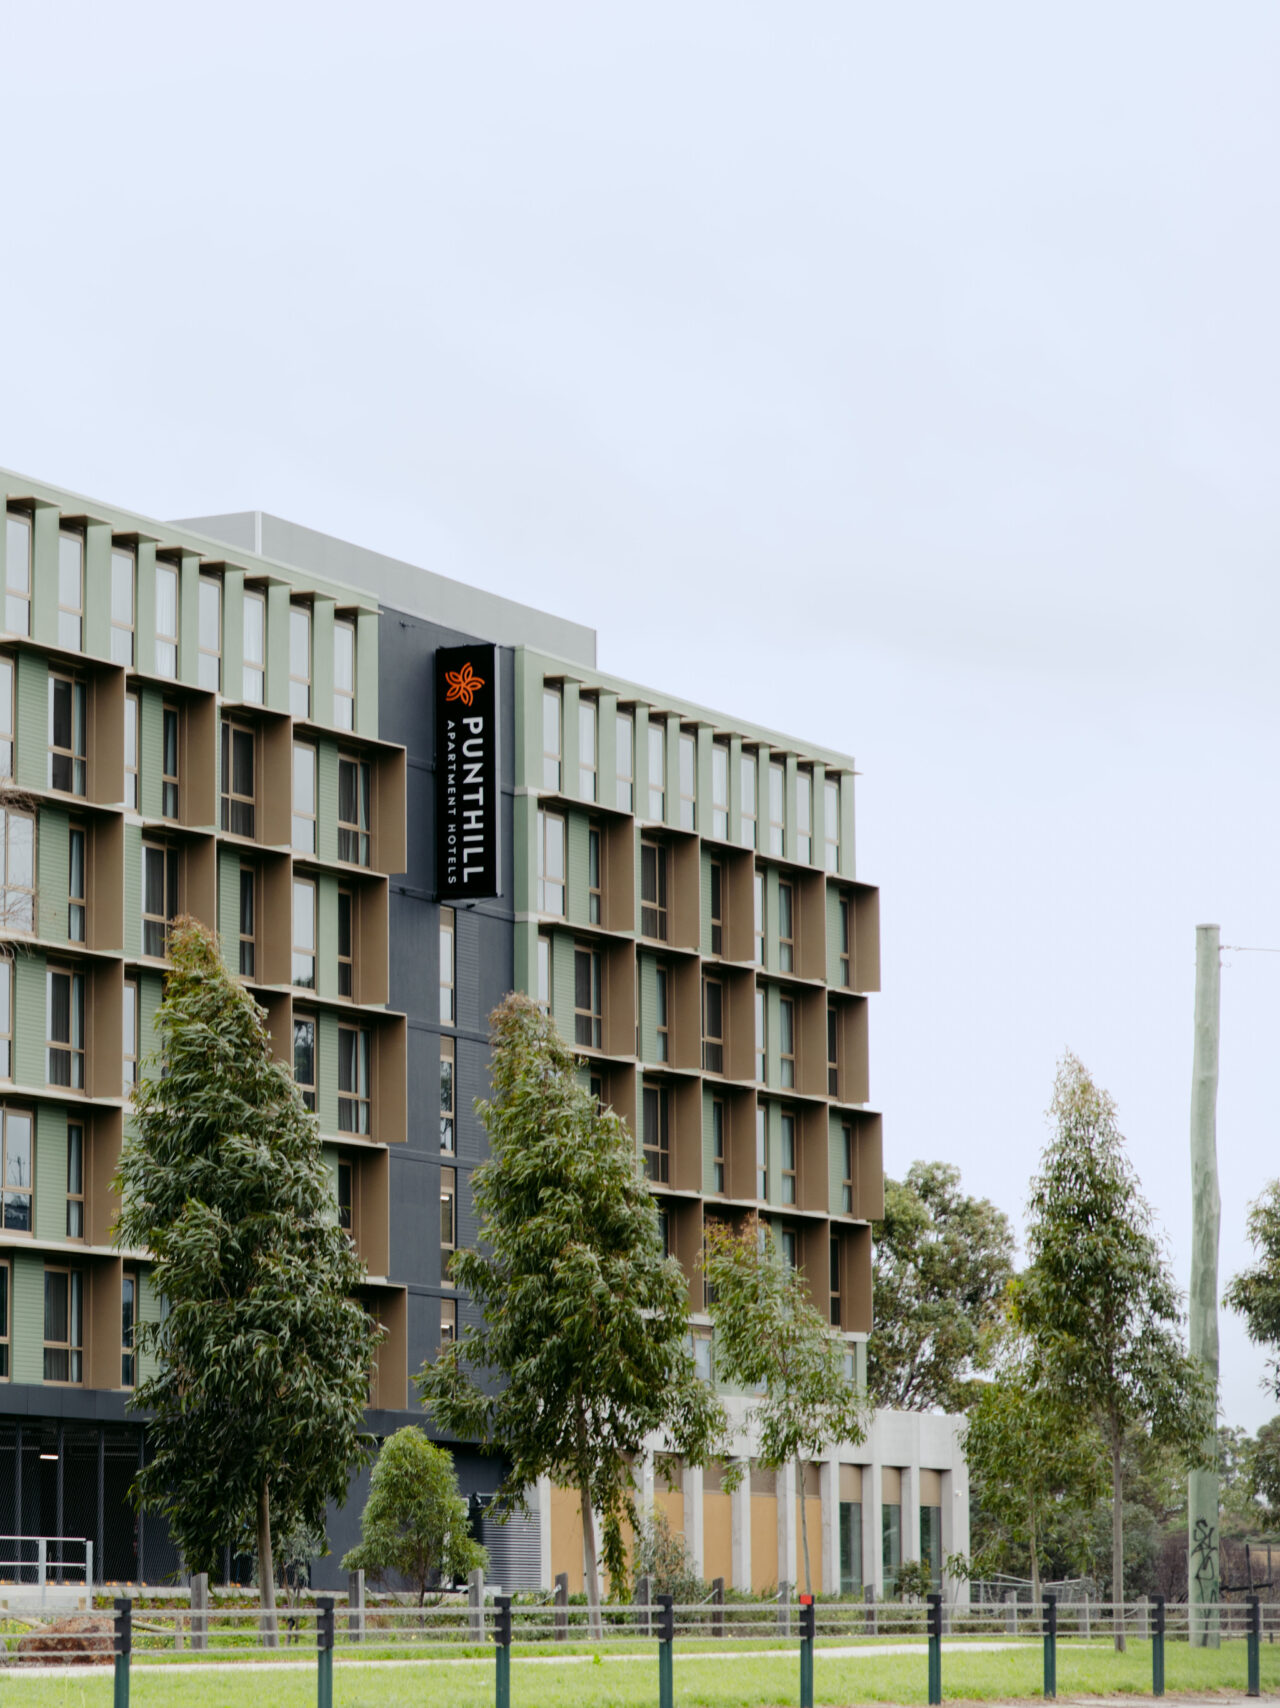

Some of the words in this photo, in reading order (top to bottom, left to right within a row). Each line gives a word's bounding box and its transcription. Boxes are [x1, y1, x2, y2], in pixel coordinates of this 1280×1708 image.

[447, 720, 456, 816] APARTMENT
[462, 716, 484, 883] PUNTHILL
[448, 824, 457, 884] HOTELS
